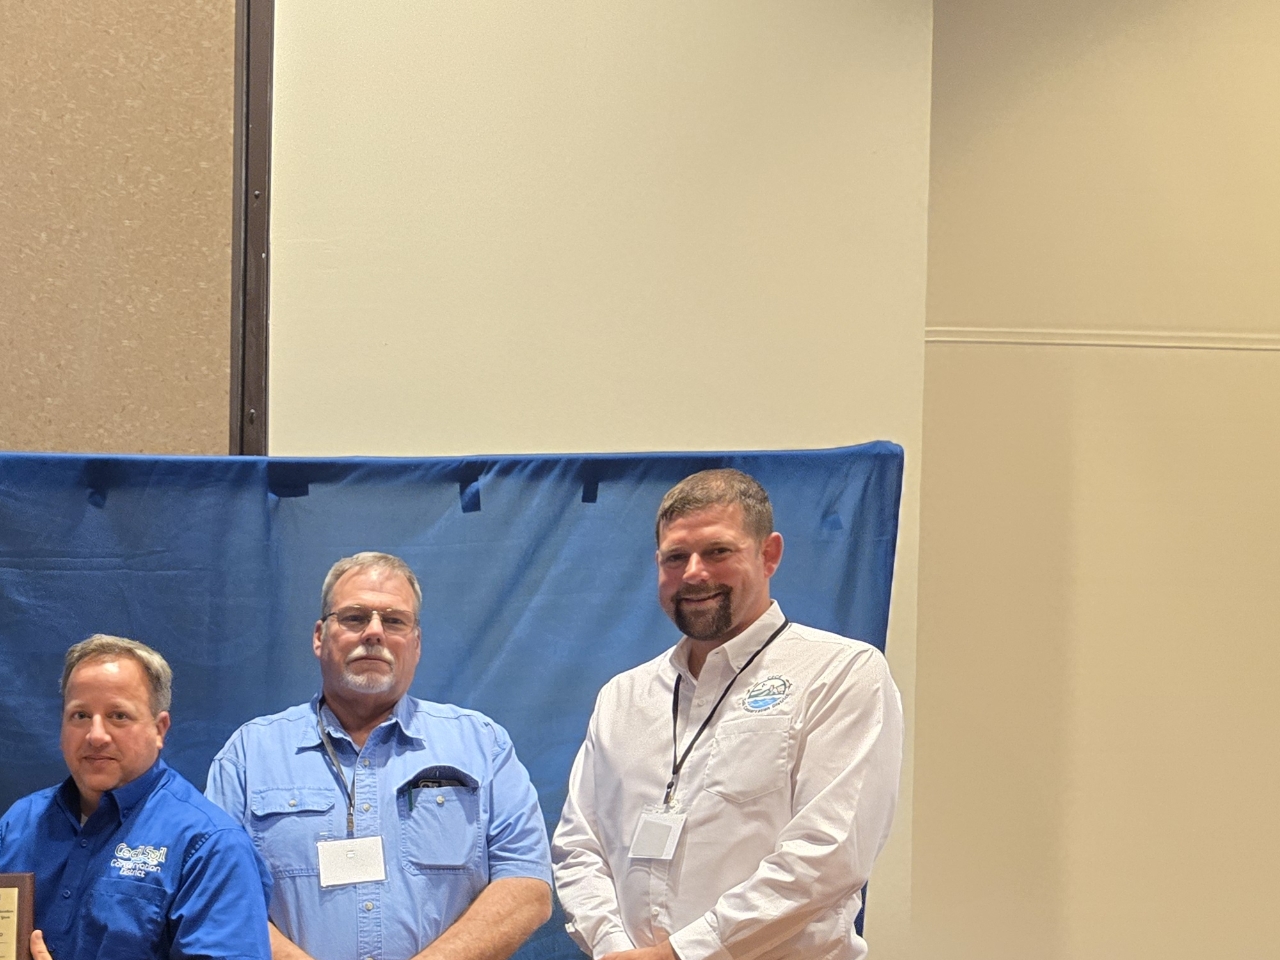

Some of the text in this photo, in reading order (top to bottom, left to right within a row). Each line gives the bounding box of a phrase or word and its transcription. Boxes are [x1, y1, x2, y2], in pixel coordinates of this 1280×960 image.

[115, 842, 167, 863] Cecil Soil
[120, 868, 146, 878] District
